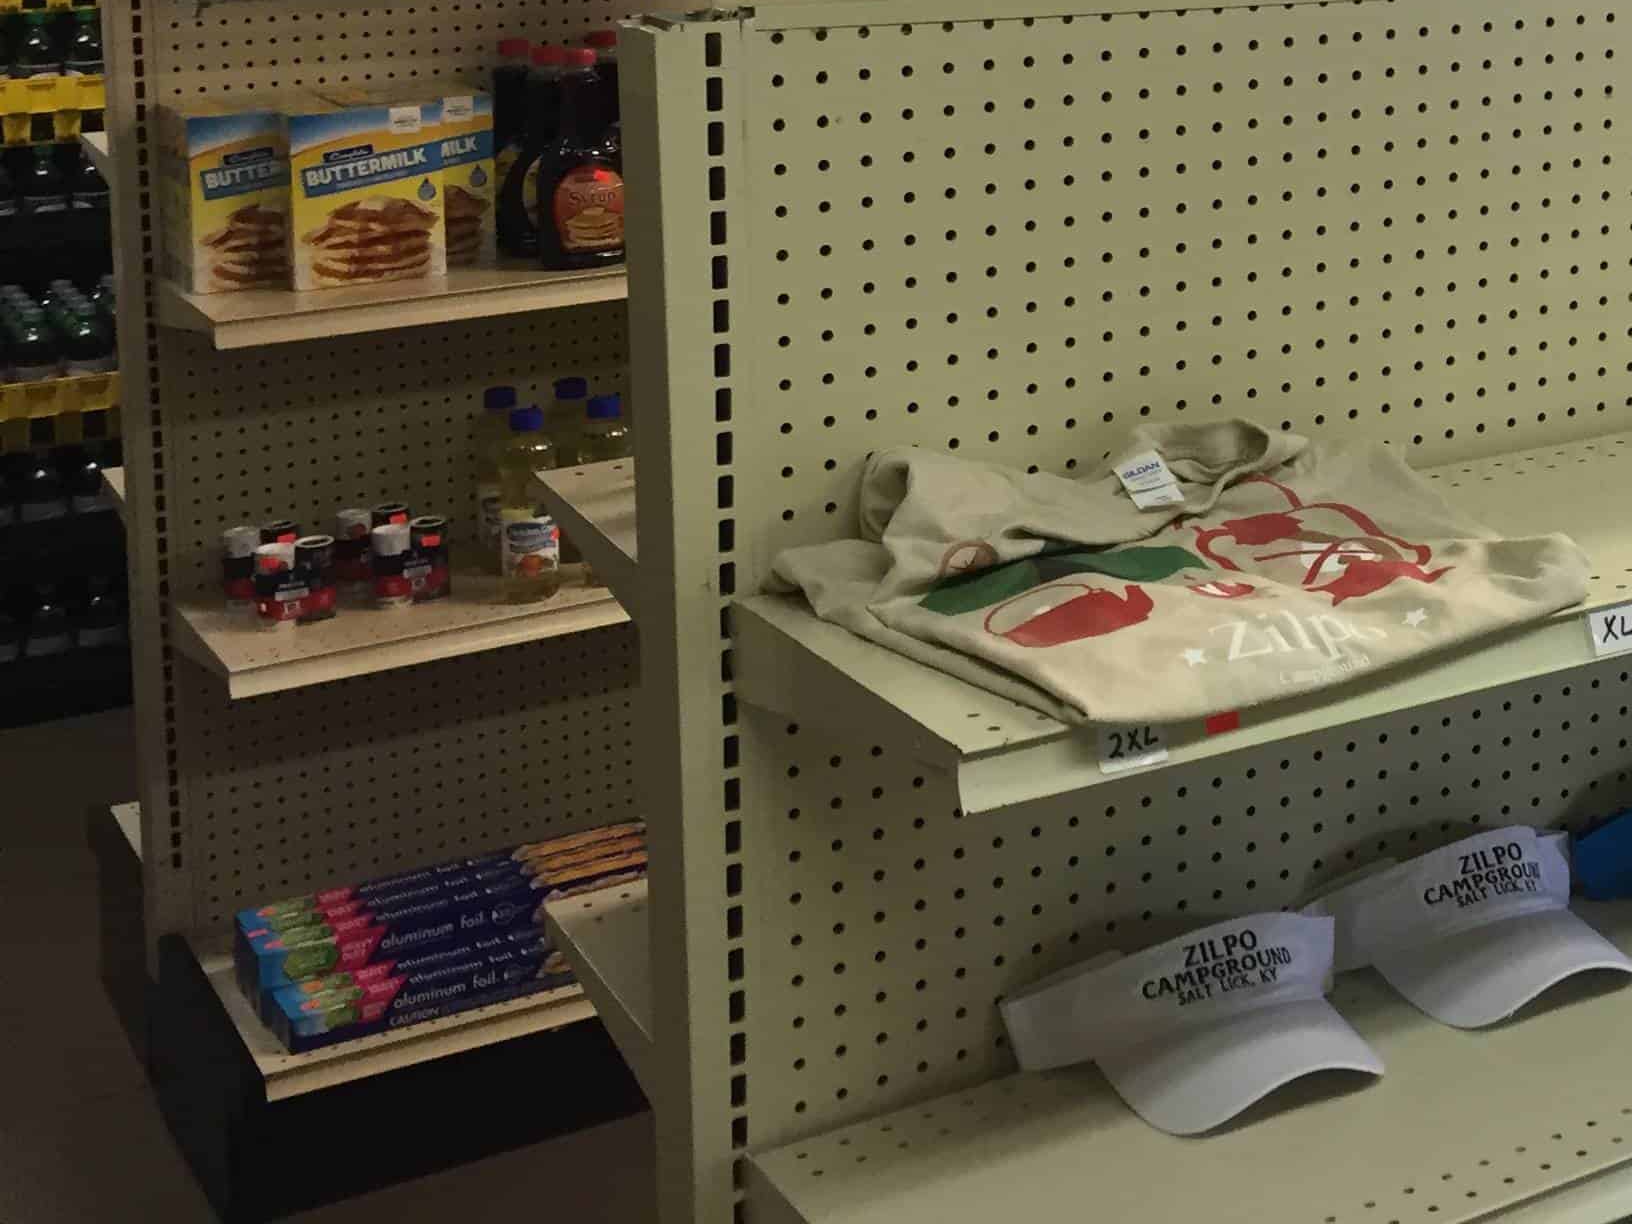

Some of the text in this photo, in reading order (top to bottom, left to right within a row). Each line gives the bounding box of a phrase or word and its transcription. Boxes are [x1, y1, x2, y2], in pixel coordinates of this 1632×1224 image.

[304, 148, 428, 187] BUTTERMILK
[1123, 461, 1160, 479] GILDAN
[1108, 724, 1159, 759] 2XL
[1458, 842, 1523, 875] ZILPO
[1423, 861, 1541, 905] CAMPGROUN
[1456, 887, 1488, 908] SALT
[381, 922, 455, 950] aluminum
[460, 909, 485, 929] foil
[1183, 928, 1258, 968] ZILPO
[393, 970, 497, 1010] aluminum foil
[1142, 946, 1292, 1000] CAMPGROUND
[1177, 983, 1212, 1006] SALT
[1259, 967, 1279, 984] KY
